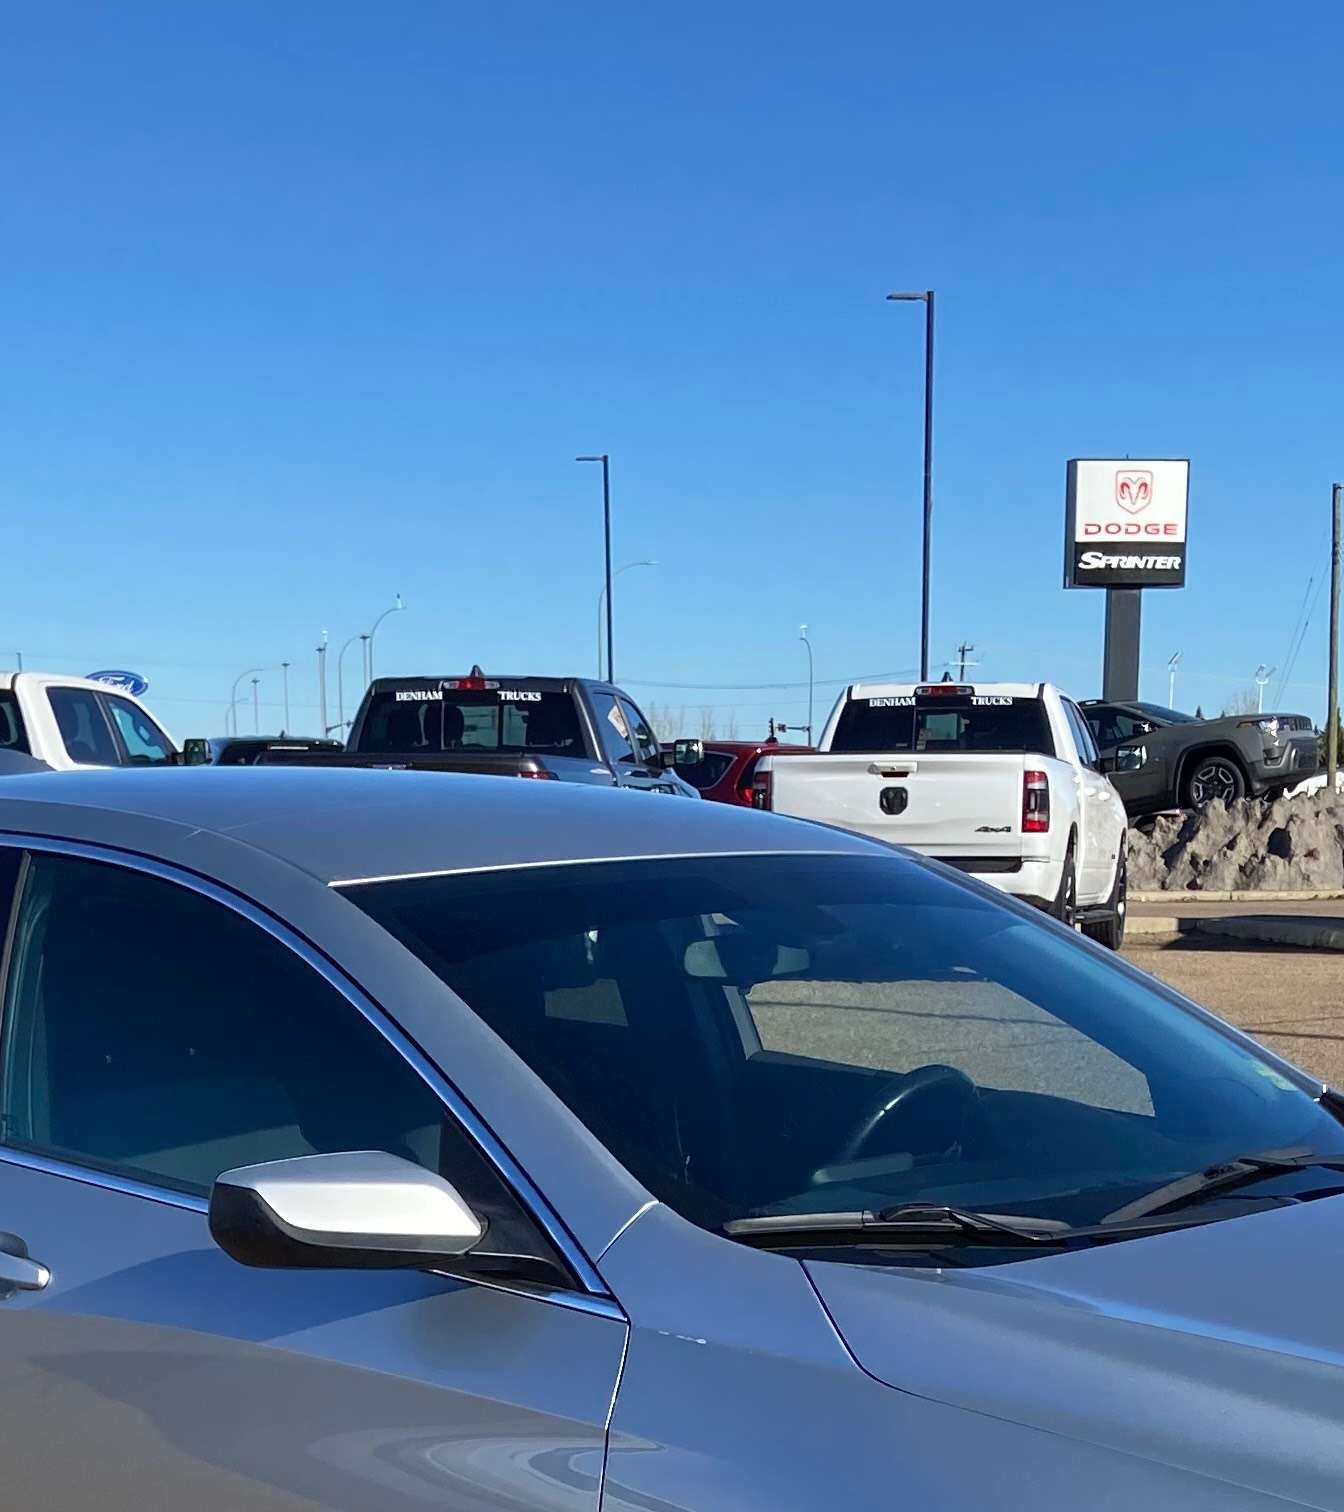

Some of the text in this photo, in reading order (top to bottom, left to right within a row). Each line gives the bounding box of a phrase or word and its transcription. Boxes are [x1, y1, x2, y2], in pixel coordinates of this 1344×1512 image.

[1084, 523, 1179, 536] DODGE
[395, 690, 542, 702] DENHAM TRUCKS
[869, 696, 1013, 708] DENHAM TRUCKS
